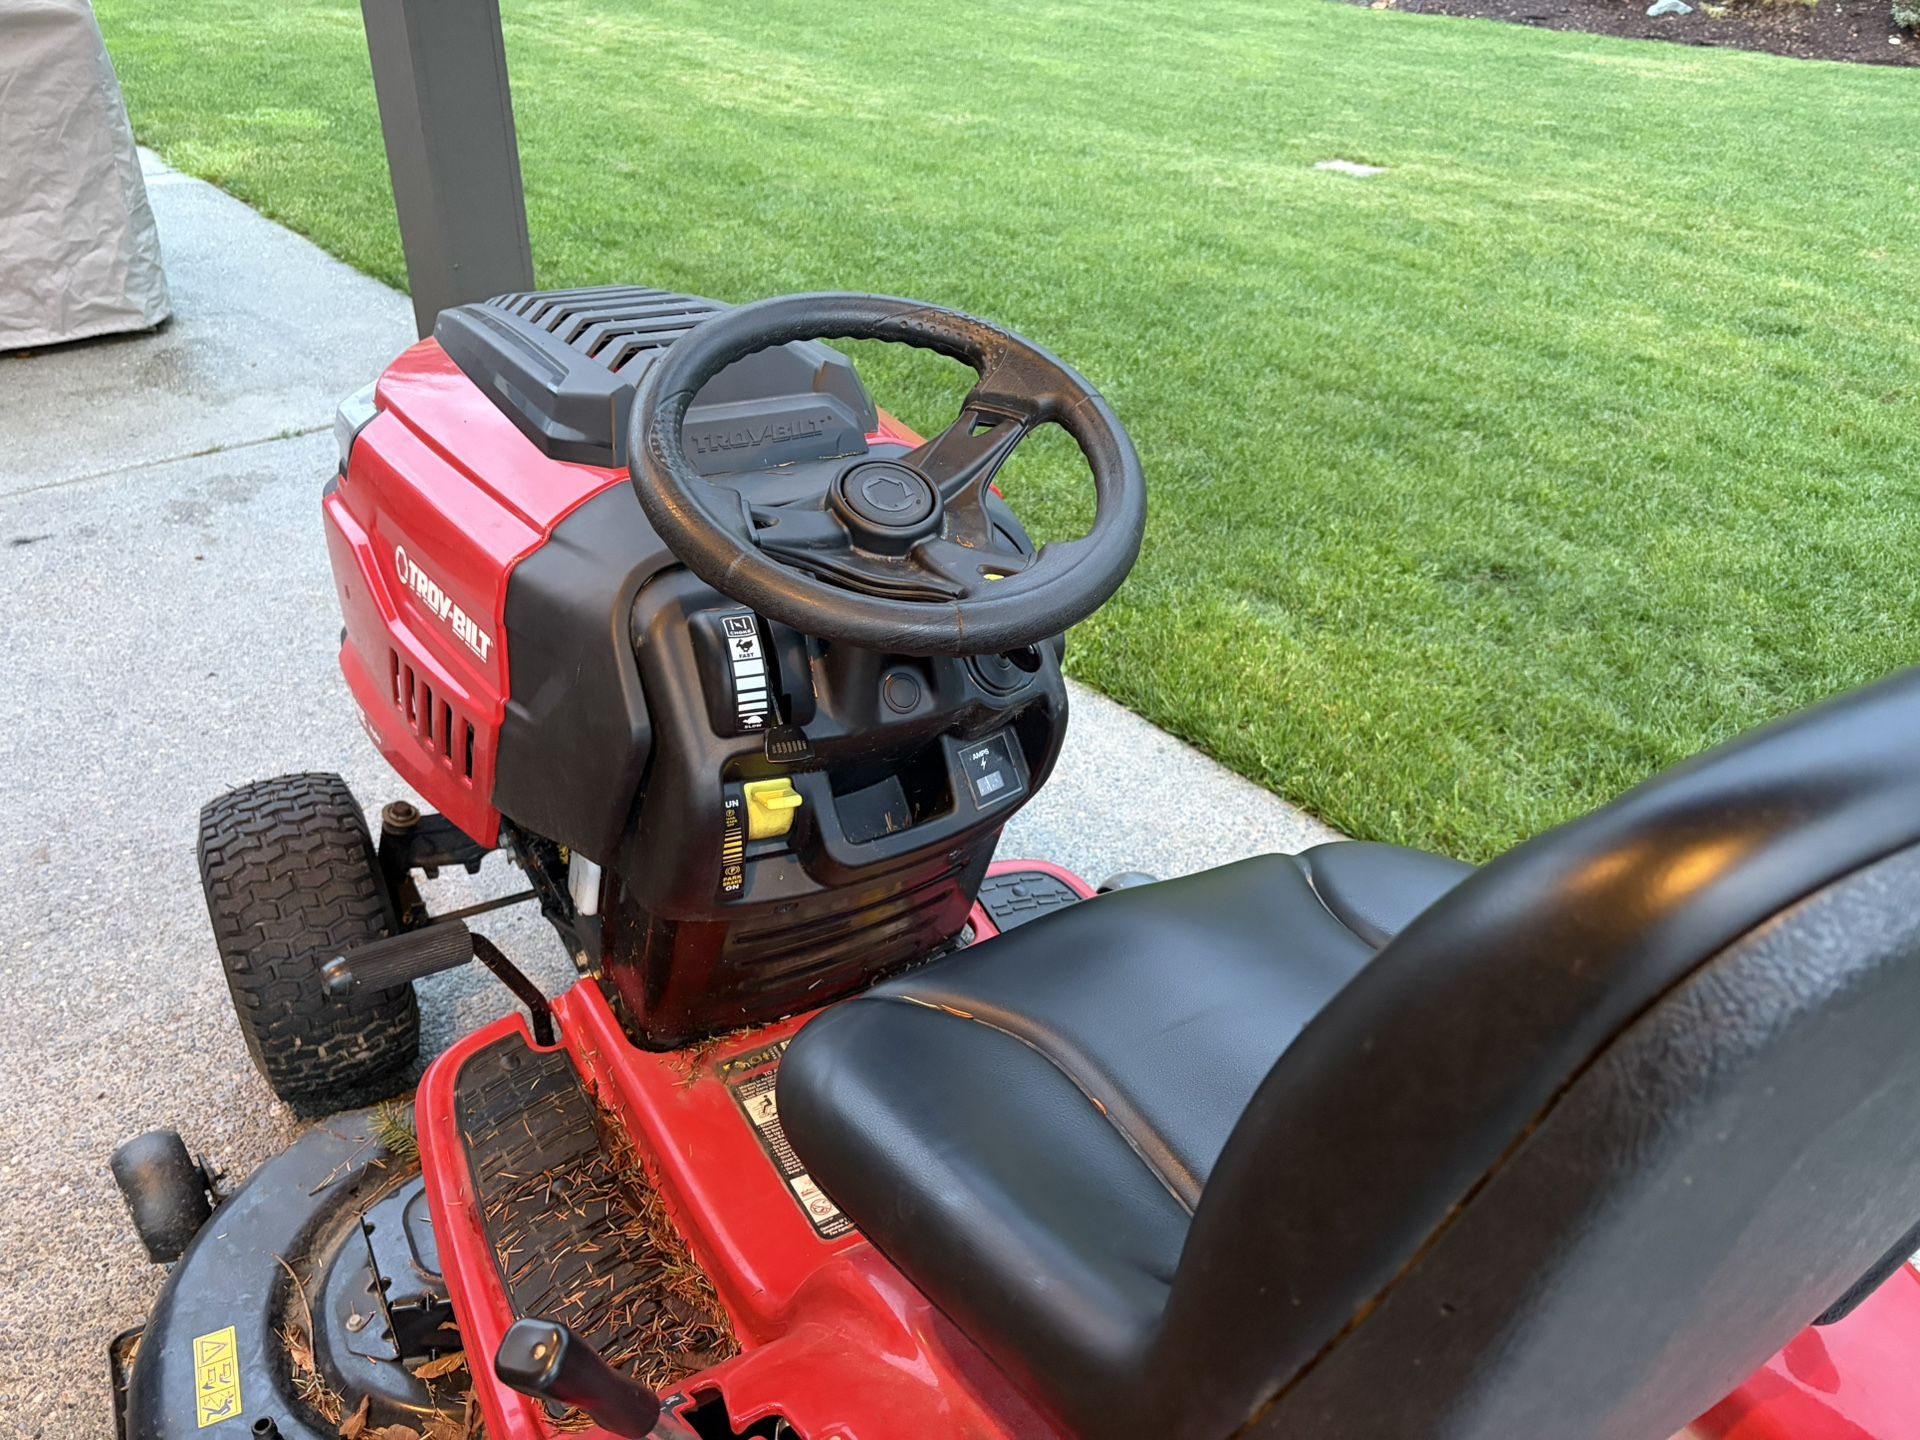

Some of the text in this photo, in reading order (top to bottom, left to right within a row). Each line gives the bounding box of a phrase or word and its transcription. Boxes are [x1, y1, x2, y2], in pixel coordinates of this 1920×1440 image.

[408, 559, 491, 663] TROY-BILT
[972, 748, 990, 760] AMPS
[723, 874, 742, 882] PARK
